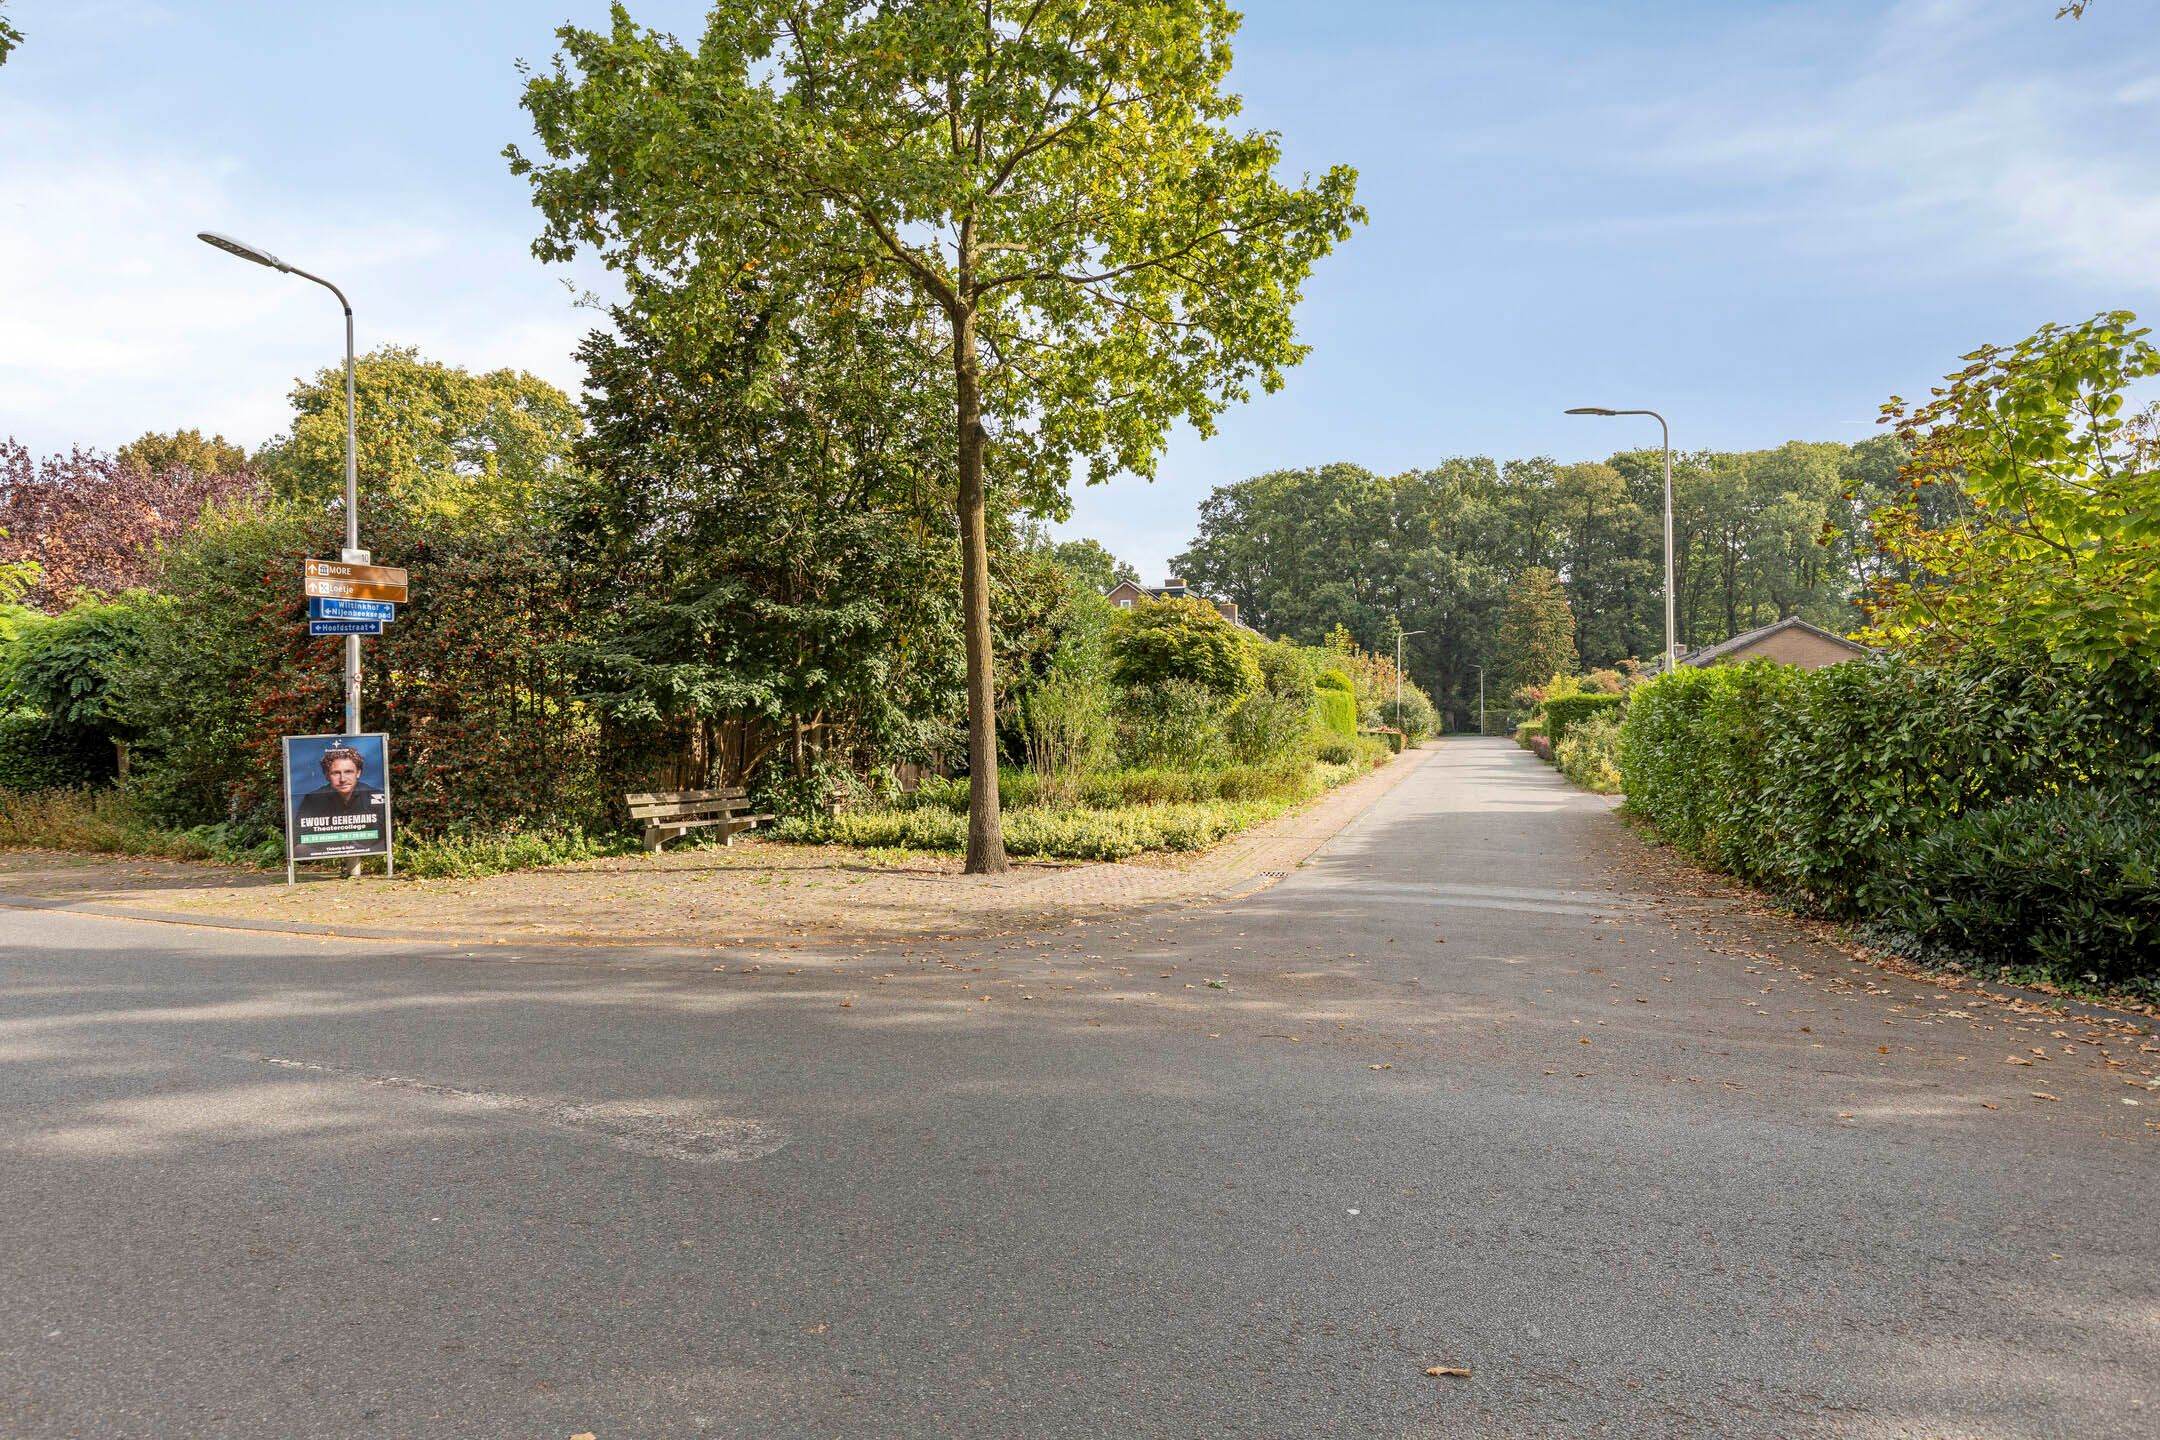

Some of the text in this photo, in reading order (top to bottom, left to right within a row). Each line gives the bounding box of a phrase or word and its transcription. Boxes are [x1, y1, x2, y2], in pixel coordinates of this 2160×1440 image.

[329, 566, 352, 576] MORE
[329, 584, 354, 595] Loetje
[338, 601, 379, 611] Wiltinkhof
[332, 608, 391, 619] Nijenbeeksepad
[322, 624, 369, 632] Hoofdstraat
[300, 814, 377, 828] EWOUT GENEMANS
[313, 824, 366, 832] Theatercollege
